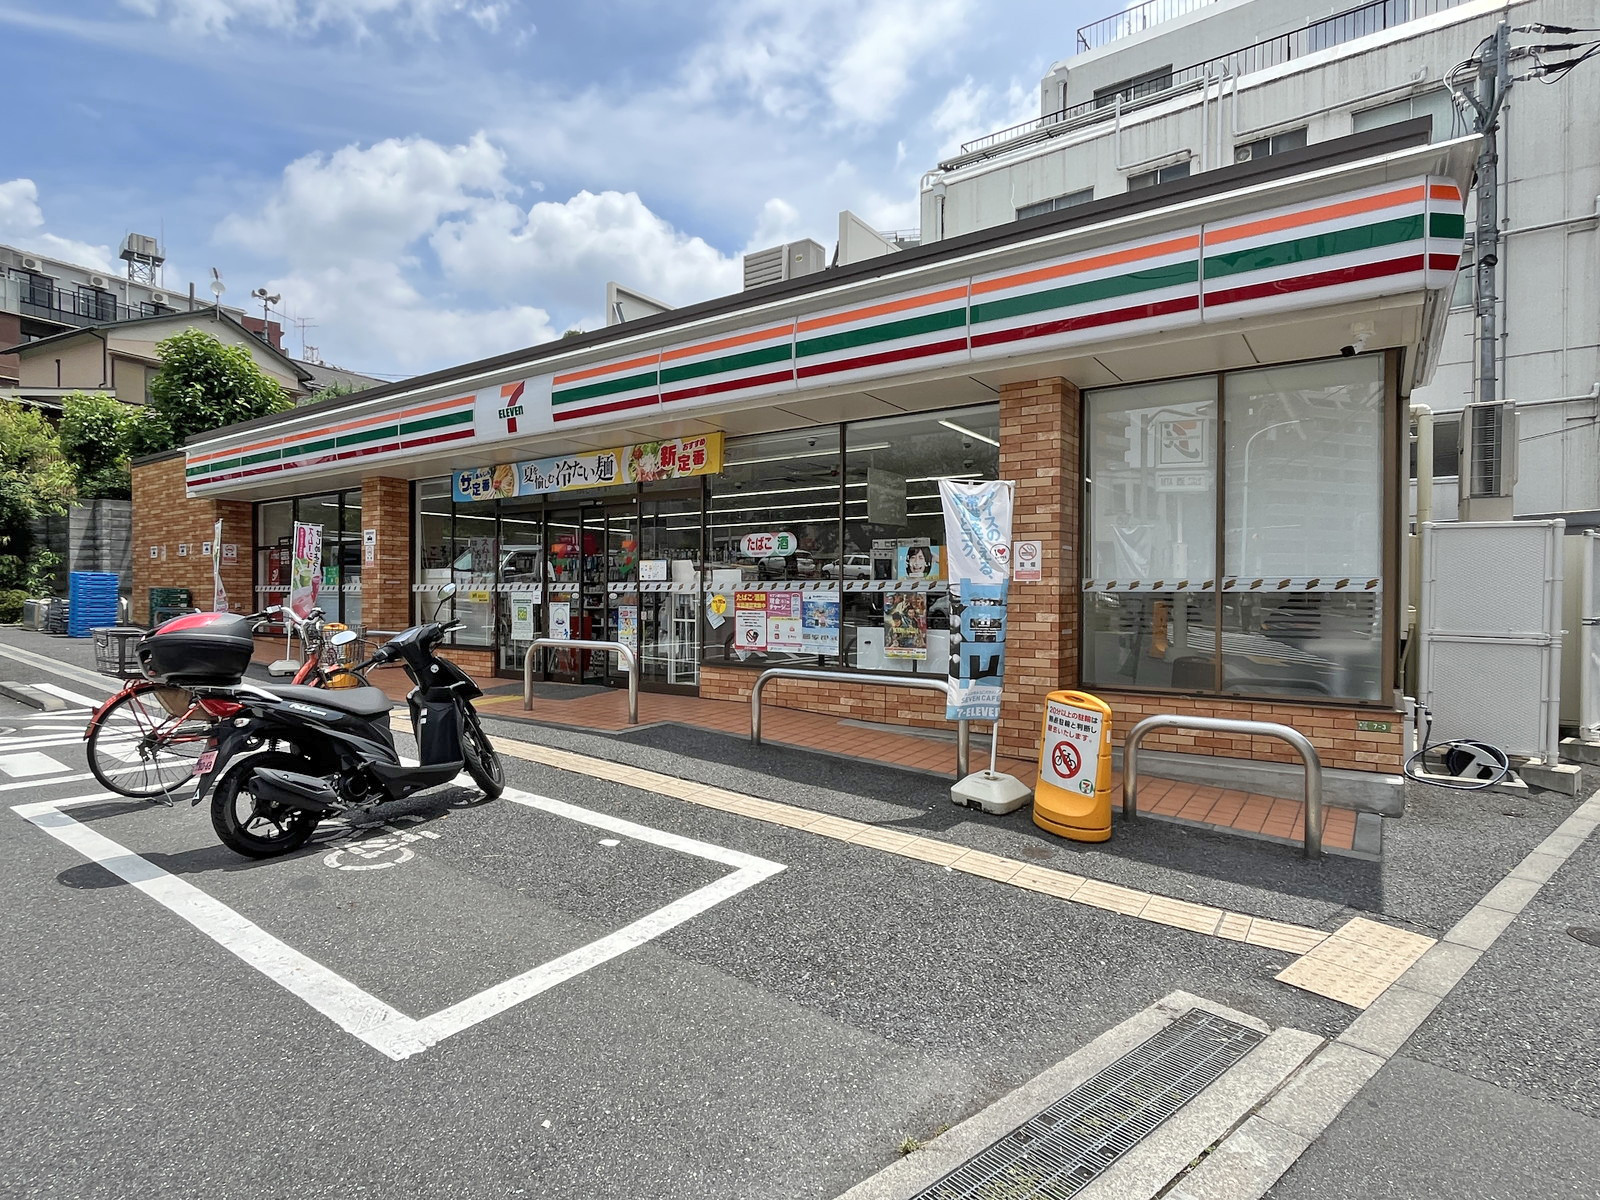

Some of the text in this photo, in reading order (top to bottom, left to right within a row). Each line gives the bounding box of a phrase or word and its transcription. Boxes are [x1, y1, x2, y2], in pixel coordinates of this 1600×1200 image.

[500, 380, 525, 433] 7
[683, 438, 706, 452] おすすめ
[660, 445, 705, 472] 新定番
[747, 535, 789, 551] たばこ 酒
[961, 694, 981, 704] SEVEN
